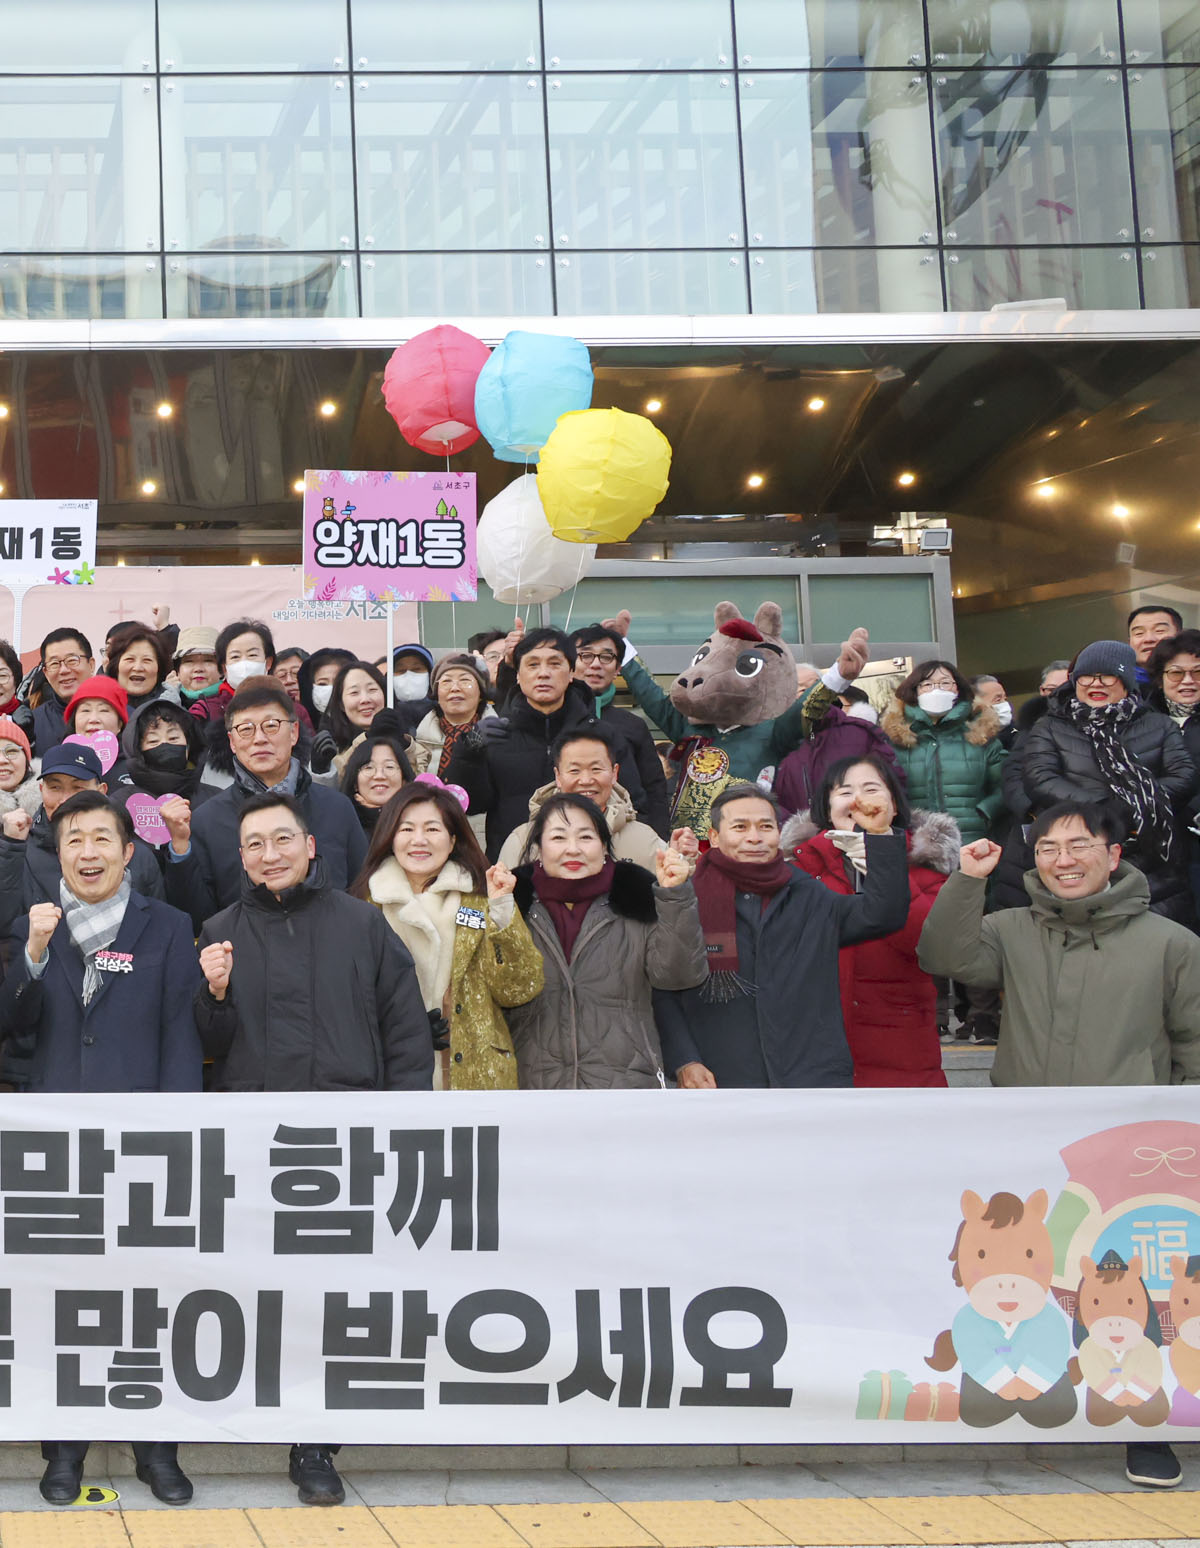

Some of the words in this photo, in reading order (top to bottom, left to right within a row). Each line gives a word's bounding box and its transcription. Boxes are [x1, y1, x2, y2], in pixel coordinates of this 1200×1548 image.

[445, 481, 471, 490] 서초구
[313, 518, 466, 568] 양재1동
[273, 611, 298, 620] 내일이
[301, 611, 344, 620] 기다려지는
[136, 814, 165, 828] 양재1
[95, 957, 133, 974] 전성수
[0, 1128, 235, 1255] 말과
[269, 1124, 499, 1255] 함께
[1131, 1221, 1190, 1281] 福
[54, 1288, 283, 1410] 많이
[322, 1286, 793, 1410] 받으세요
